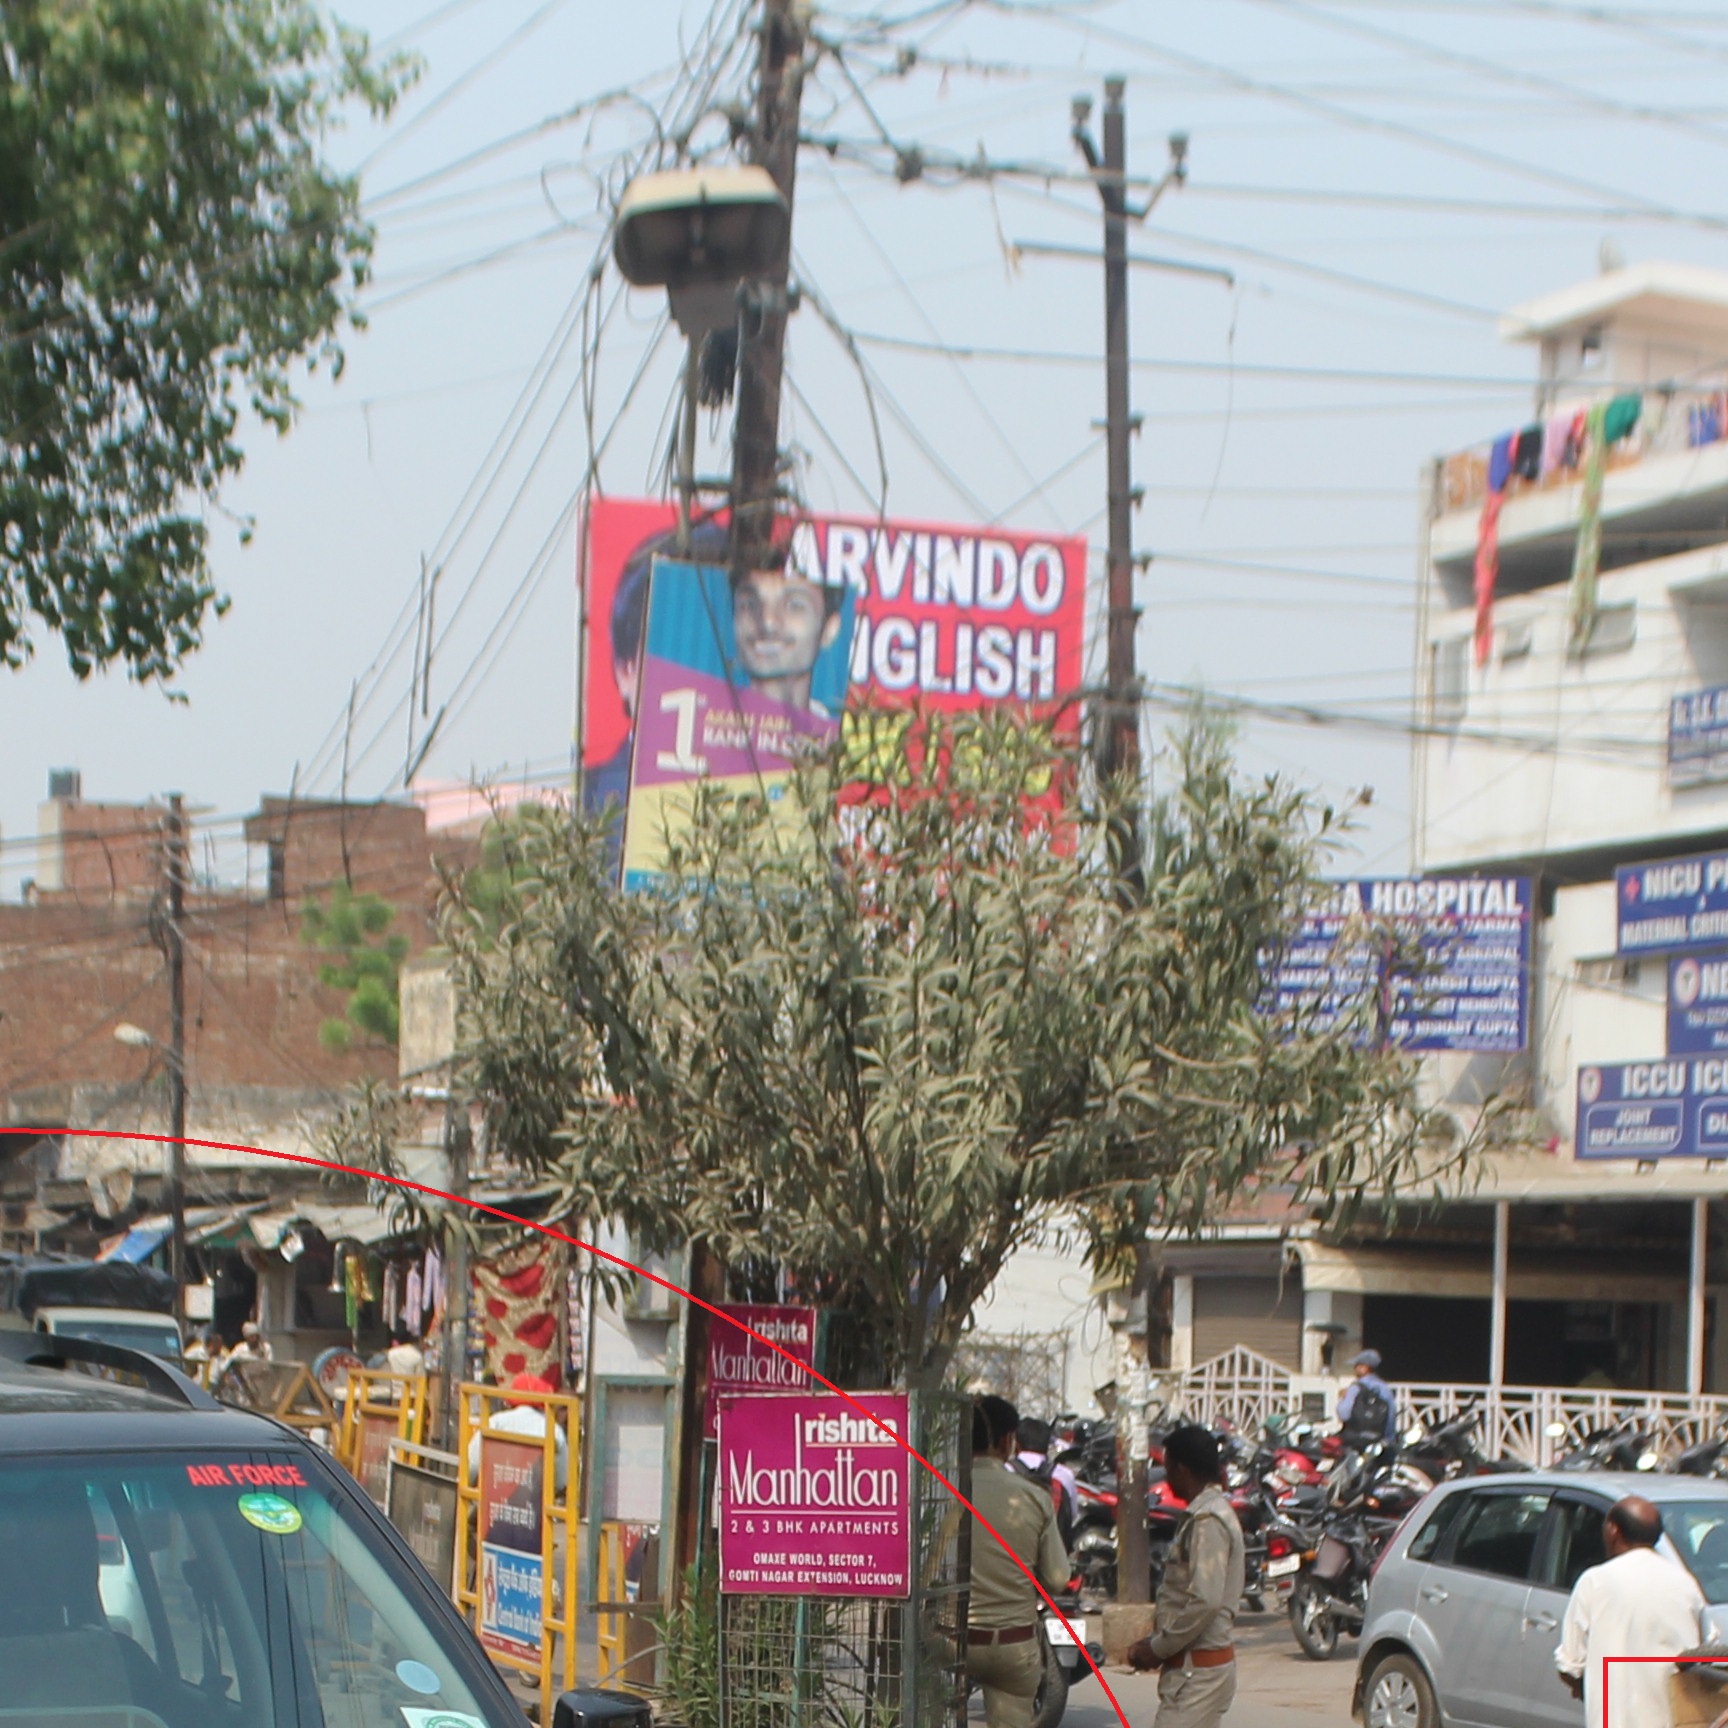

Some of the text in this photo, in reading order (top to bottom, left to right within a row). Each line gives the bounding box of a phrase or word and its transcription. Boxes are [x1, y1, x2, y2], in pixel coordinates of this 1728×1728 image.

[784, 521, 1066, 616] ARVINDO
[1371, 879, 1524, 915] HOSPITAL
[1641, 861, 1703, 902] NICU
[1622, 914, 1690, 948] MATERNAL
[1621, 1060, 1685, 1098] ICCU
[1615, 1108, 1652, 1127] JOINT
[1590, 1126, 1678, 1146] REPLACEMENT
[805, 1412, 898, 1443] rishita
[729, 1413, 898, 1506] Manhattan
[186, 1464, 308, 1487] AIR FORCE
[731, 1521, 899, 1535] 2 & 3 BHK APARTMENTS
[753, 1552, 876, 1568] OMAXE WORLD, SECTOR 7,
[728, 1569, 903, 1586] GOMTI NAGAR EXTENSION, LUCKNOW
